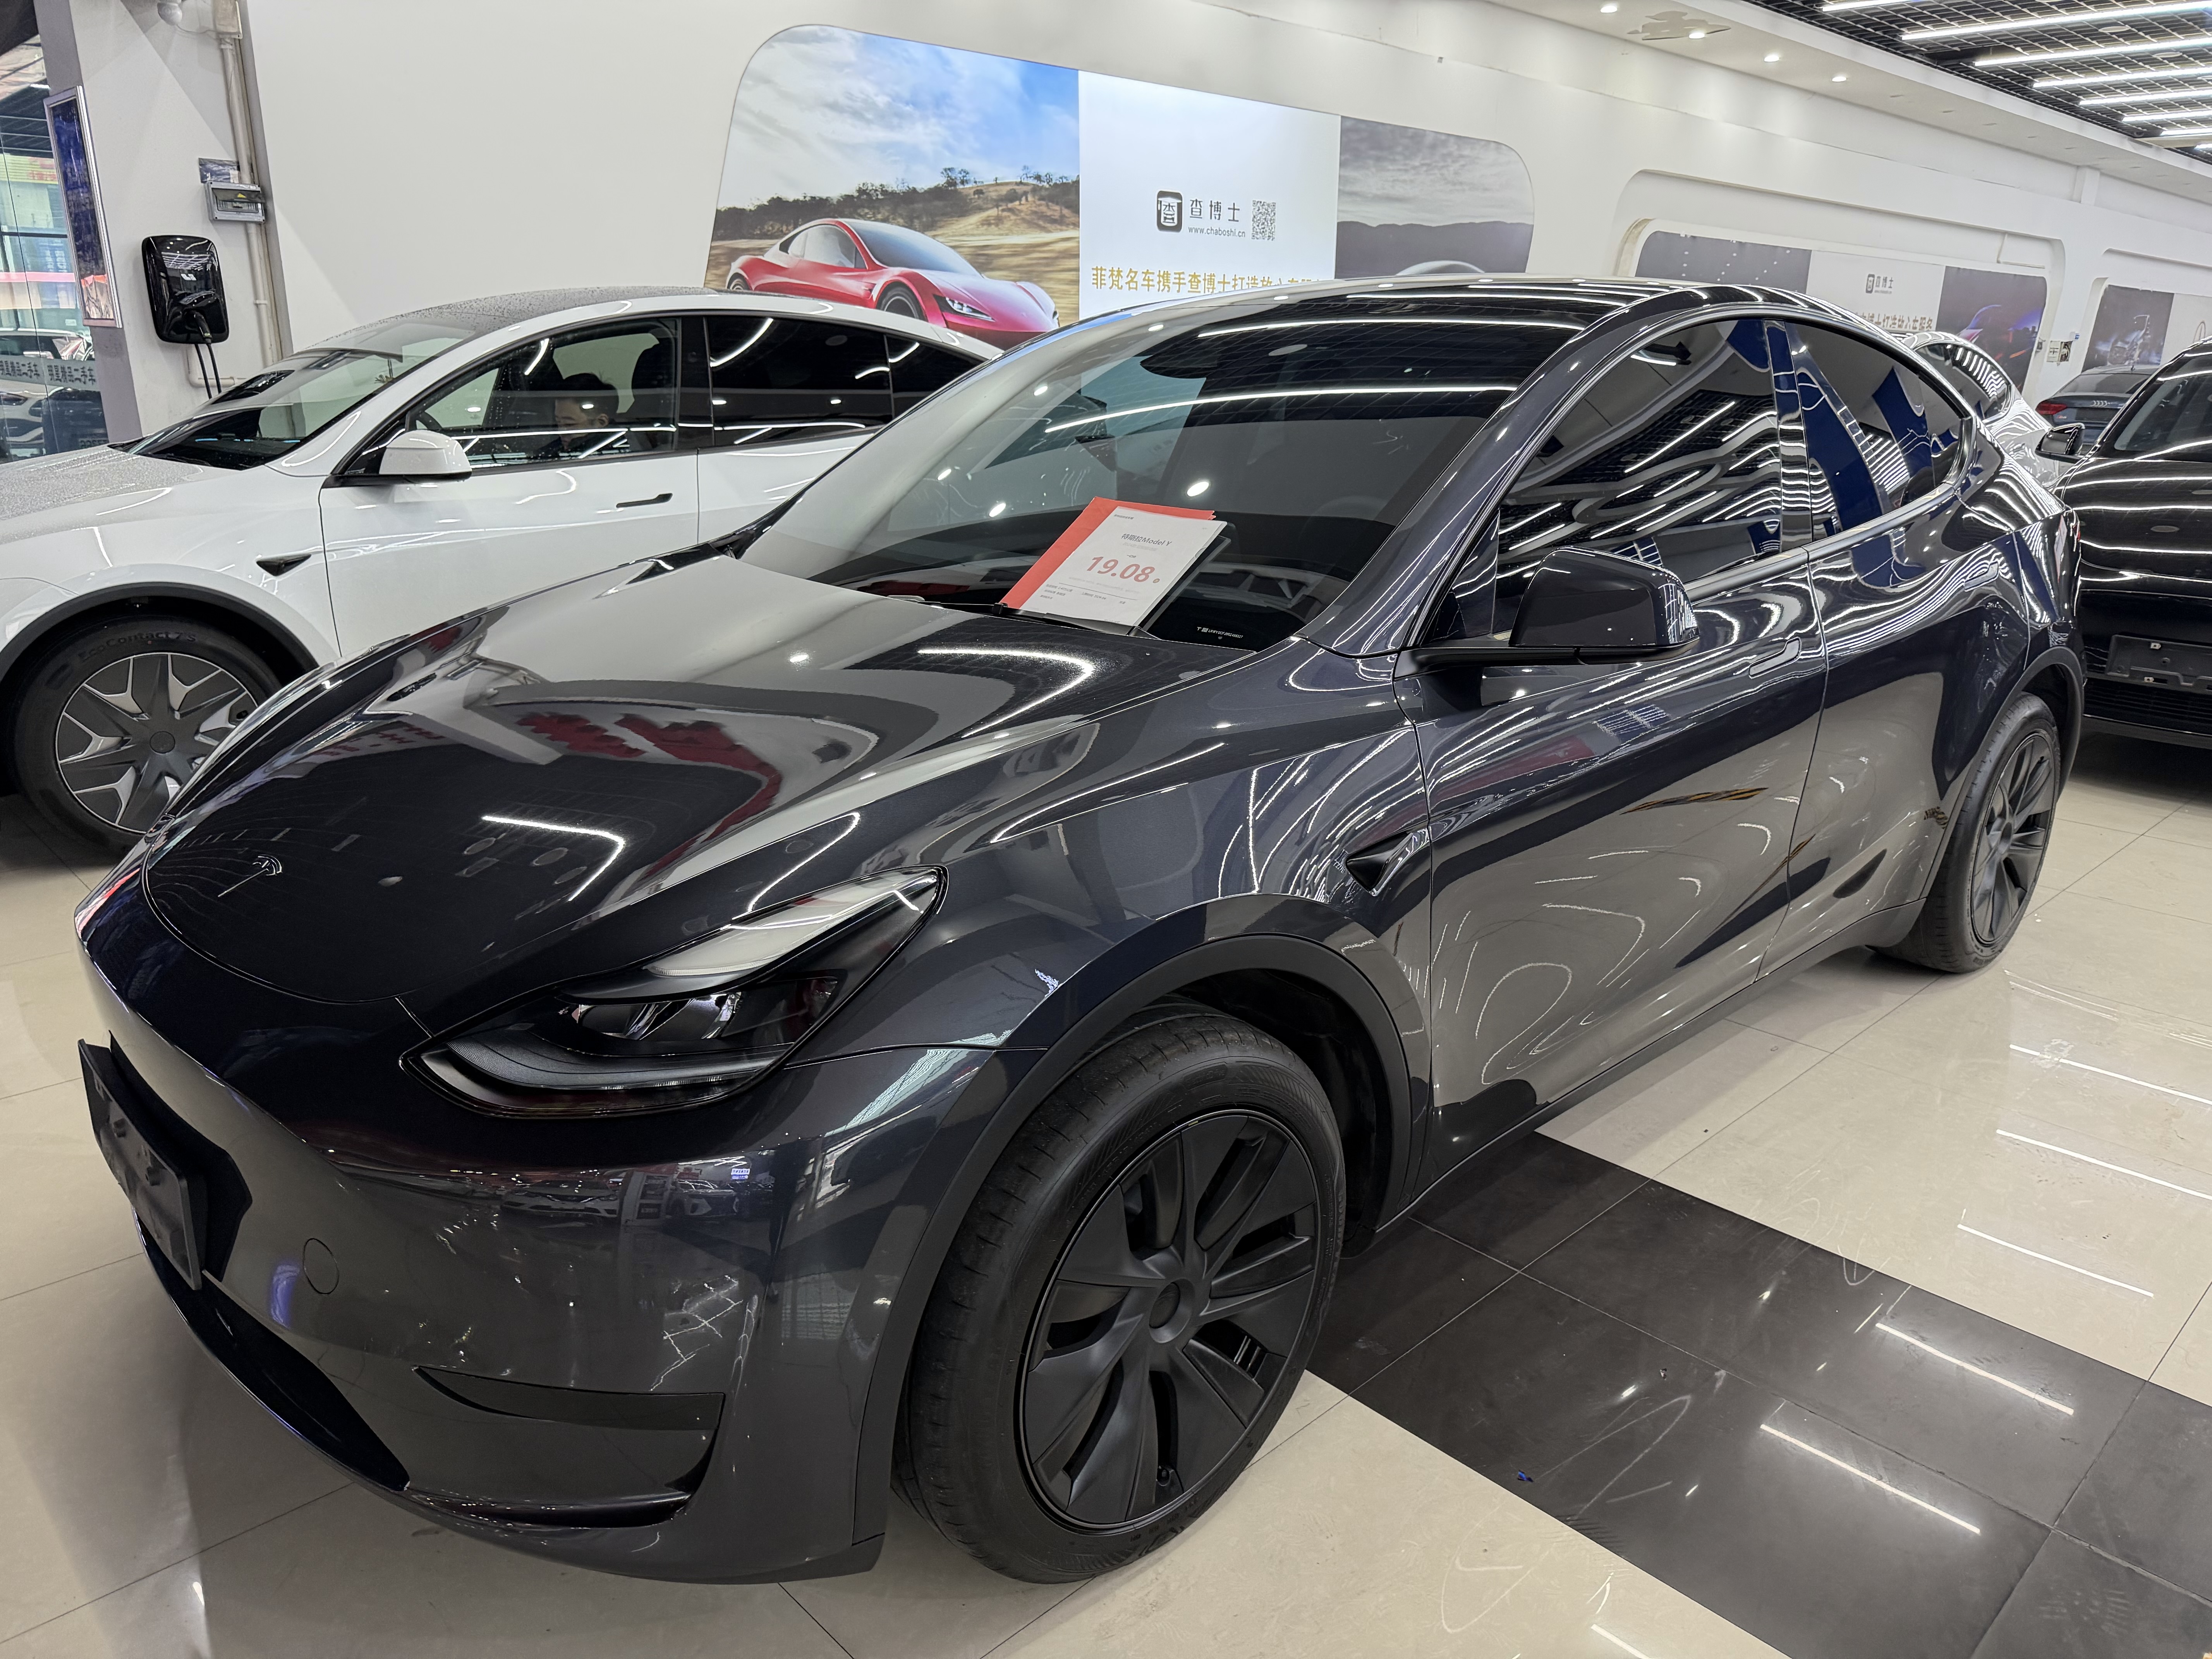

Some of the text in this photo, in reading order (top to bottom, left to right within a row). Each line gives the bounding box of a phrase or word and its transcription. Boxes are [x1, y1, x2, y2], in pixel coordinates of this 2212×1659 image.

[1190, 199, 1240, 222] 查博士
[1188, 226, 1246, 238] www.chaboshi.cn
[1121, 533, 1166, 546] 特斯拉Model
[1087, 556, 1155, 582] 19.08
